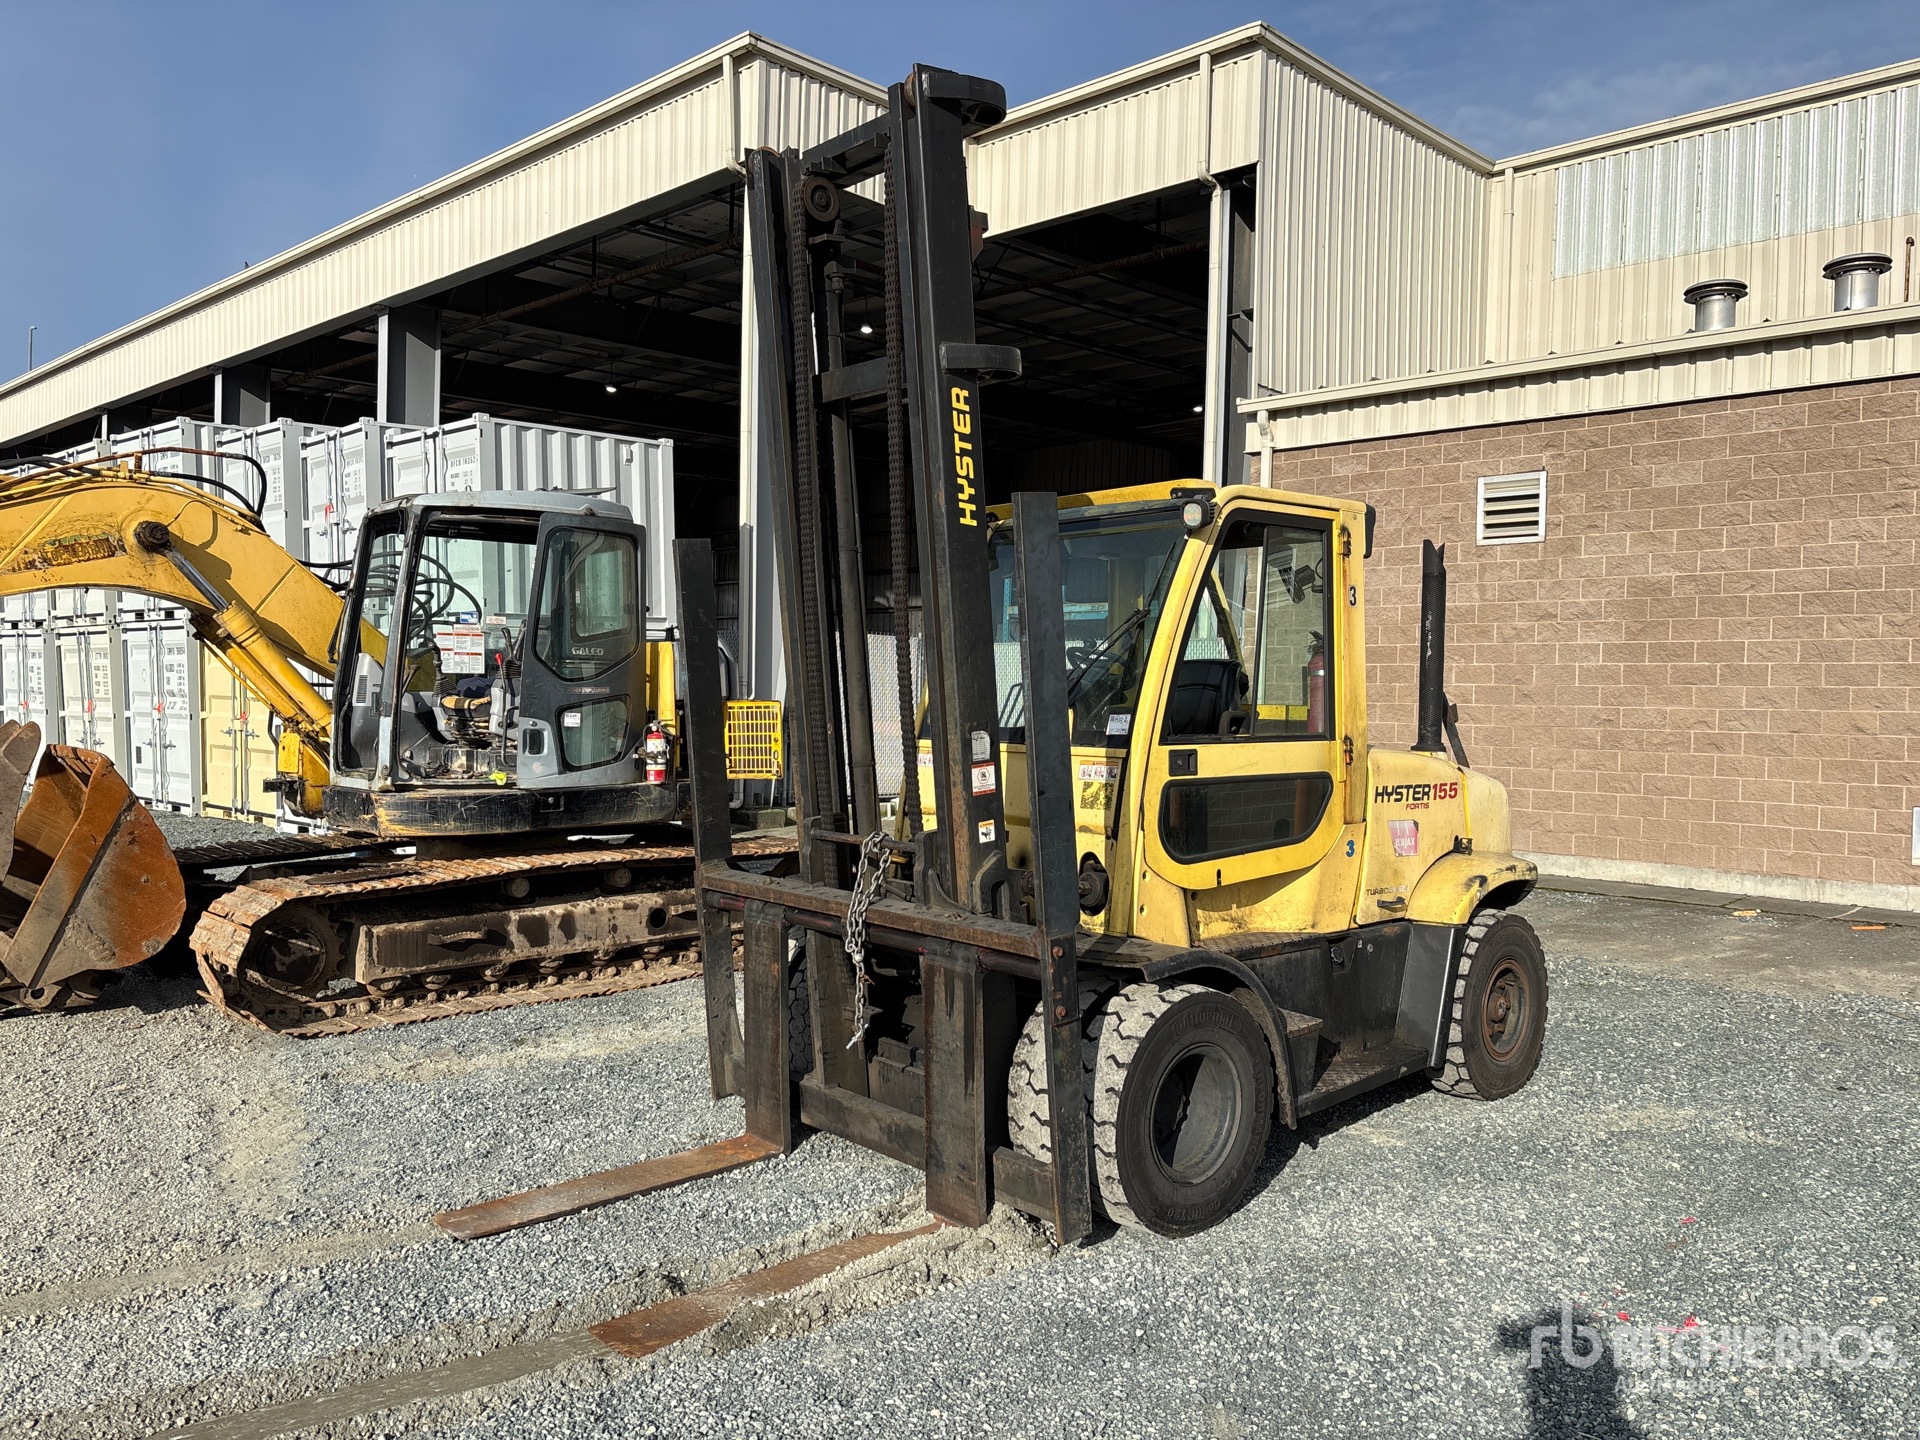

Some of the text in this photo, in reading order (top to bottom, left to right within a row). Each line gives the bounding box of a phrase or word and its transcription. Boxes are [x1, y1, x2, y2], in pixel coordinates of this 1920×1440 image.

[950, 386, 978, 527] HYSTER
[1349, 585, 1357, 607] 3
[1374, 782, 1459, 804] HYSTER 155
[1405, 802, 1430, 811] FORTIS
[1345, 839, 1355, 858] 3
